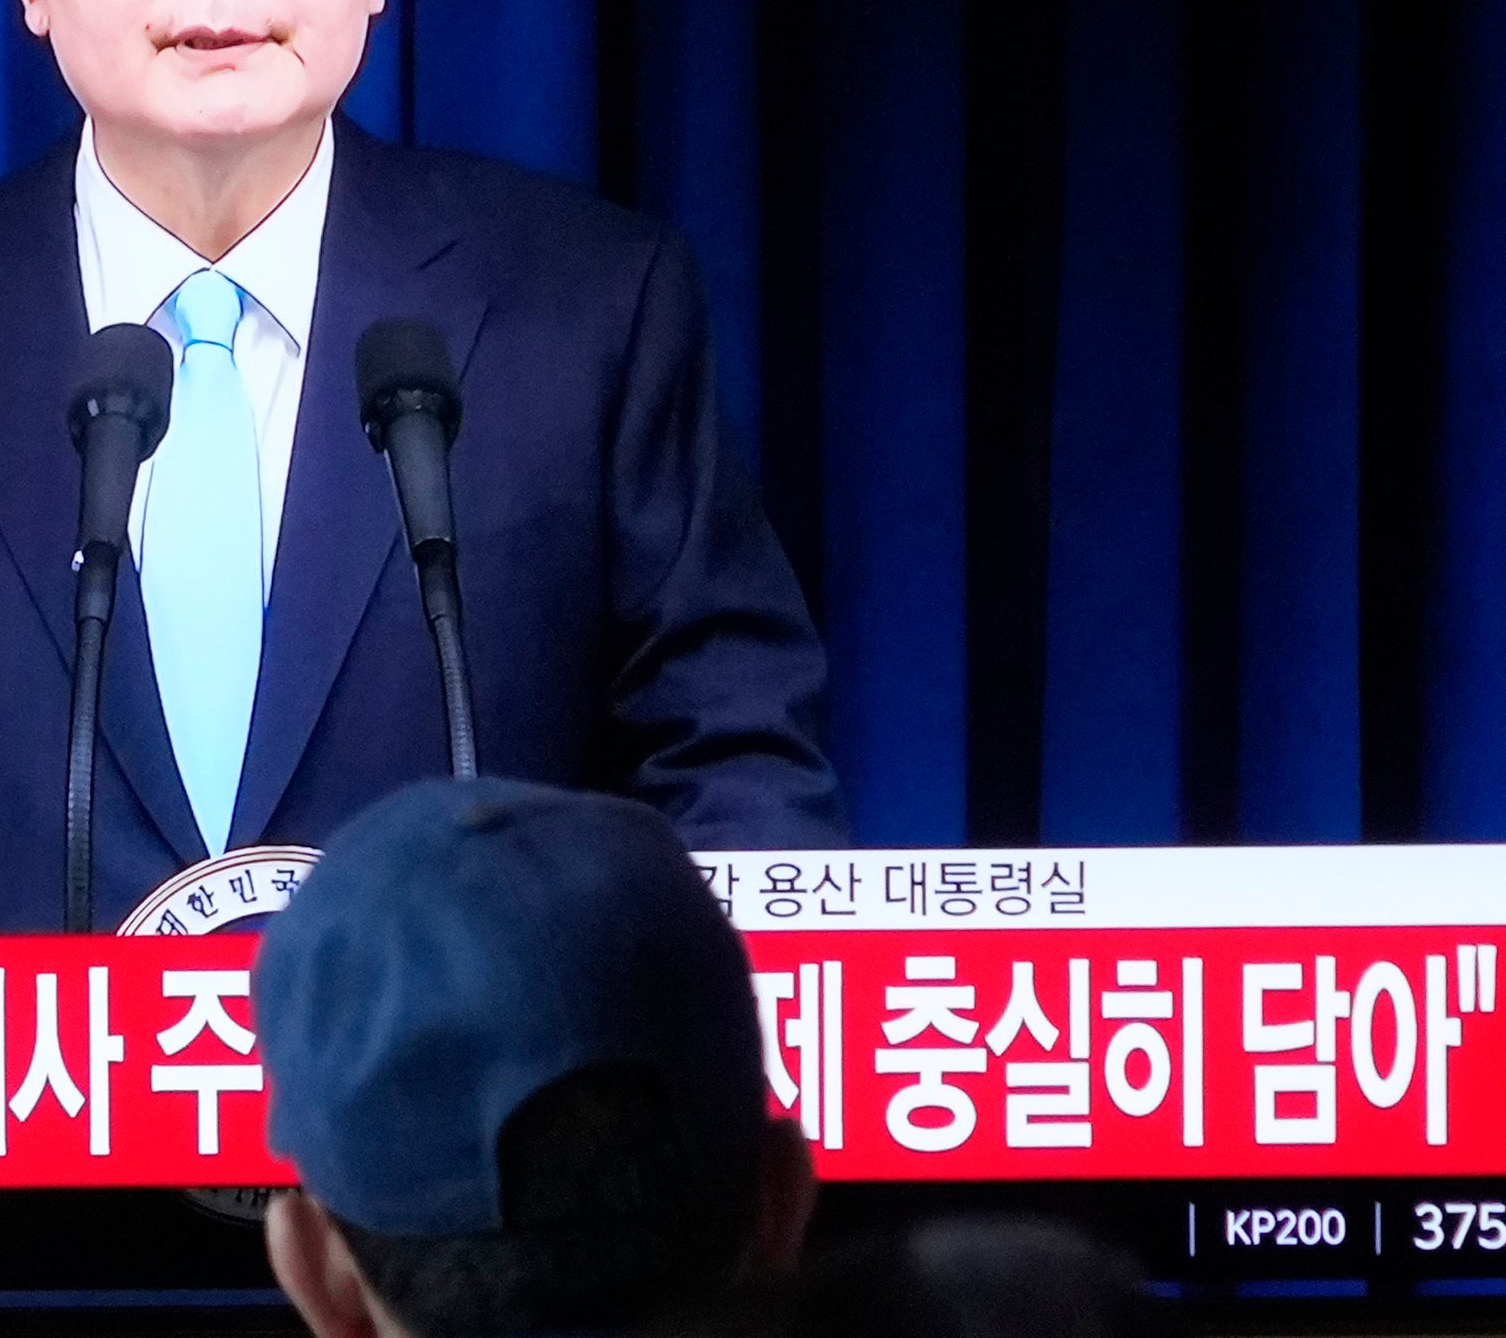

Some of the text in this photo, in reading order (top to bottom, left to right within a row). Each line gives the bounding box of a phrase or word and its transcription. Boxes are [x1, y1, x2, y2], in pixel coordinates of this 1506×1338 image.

[758, 861, 862, 918] 용산
[884, 860, 1087, 918] 대통령실
[150, 970, 265, 1156] 주
[874, 955, 1204, 1153] 충실히
[1240, 943, 1498, 1148] 담아"
[1225, 1208, 1347, 1247] KP200
